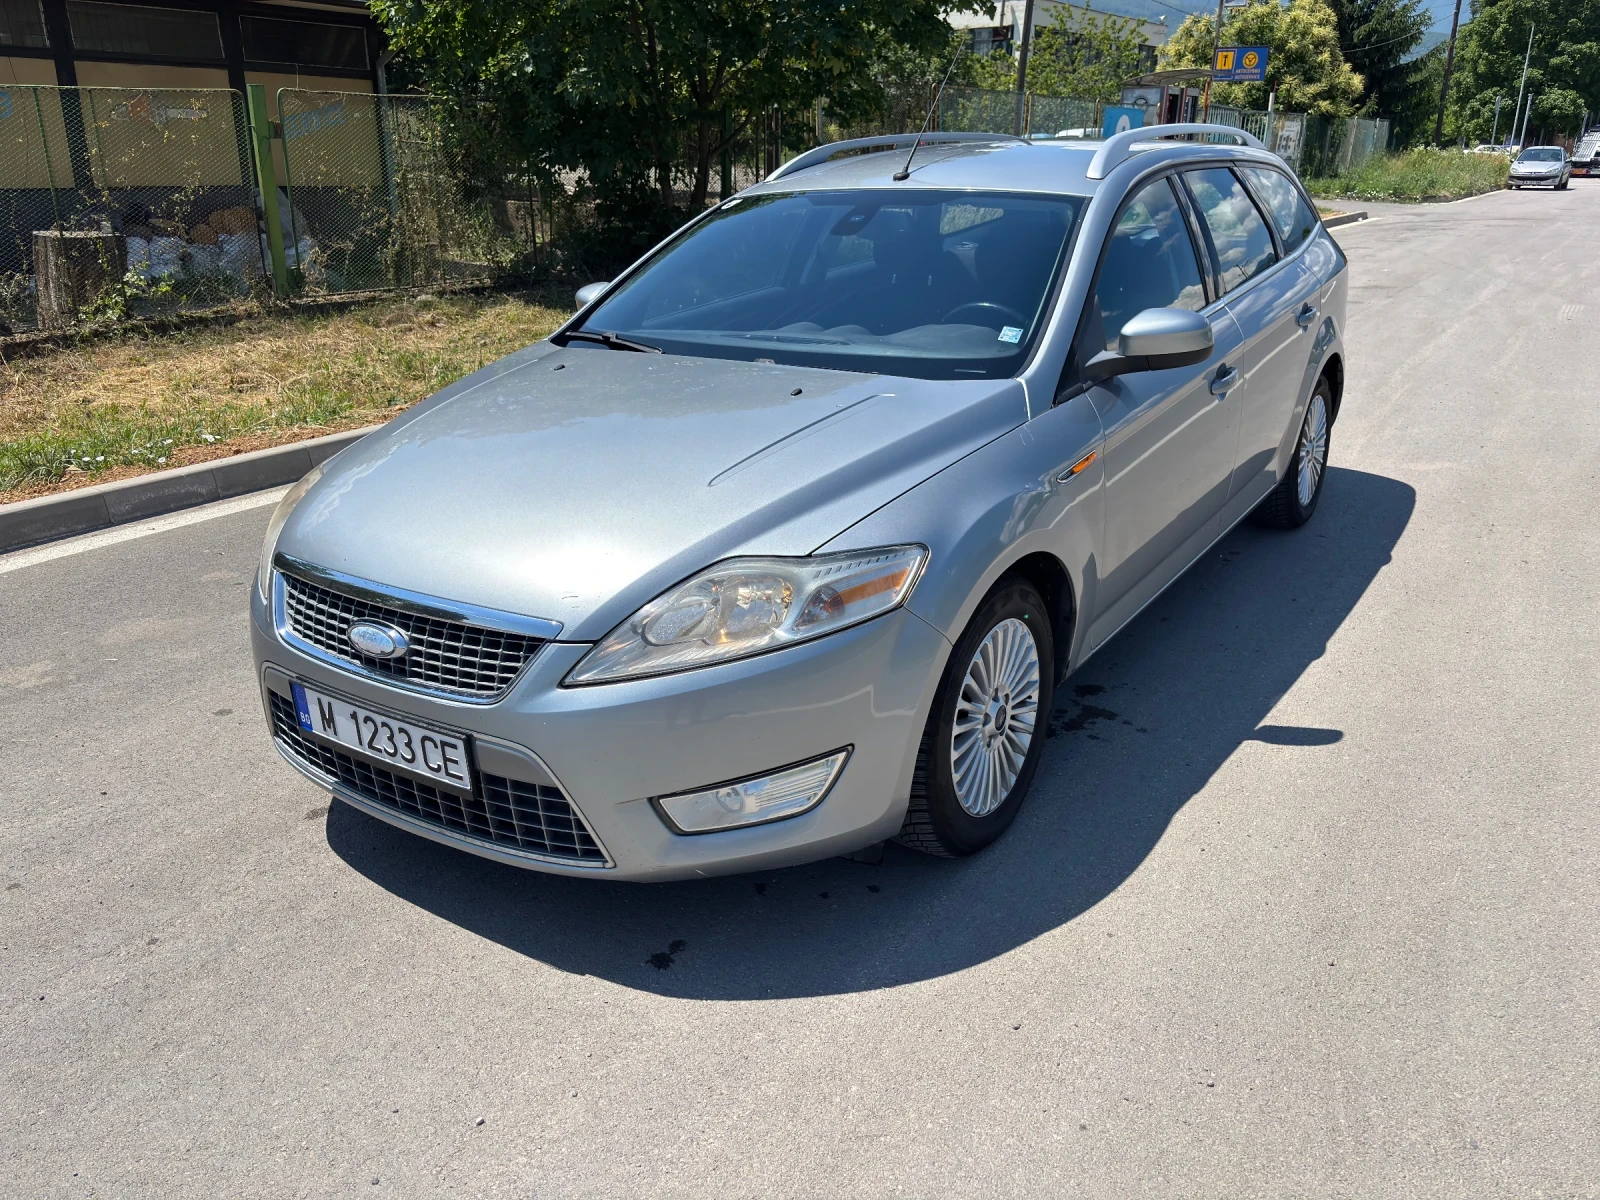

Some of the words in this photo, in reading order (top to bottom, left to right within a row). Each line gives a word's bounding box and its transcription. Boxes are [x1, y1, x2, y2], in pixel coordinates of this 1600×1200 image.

[300, 711, 311, 725] BG
[317, 697, 338, 737] M
[350, 710, 416, 764] 1233
[421, 735, 464, 782] CE
